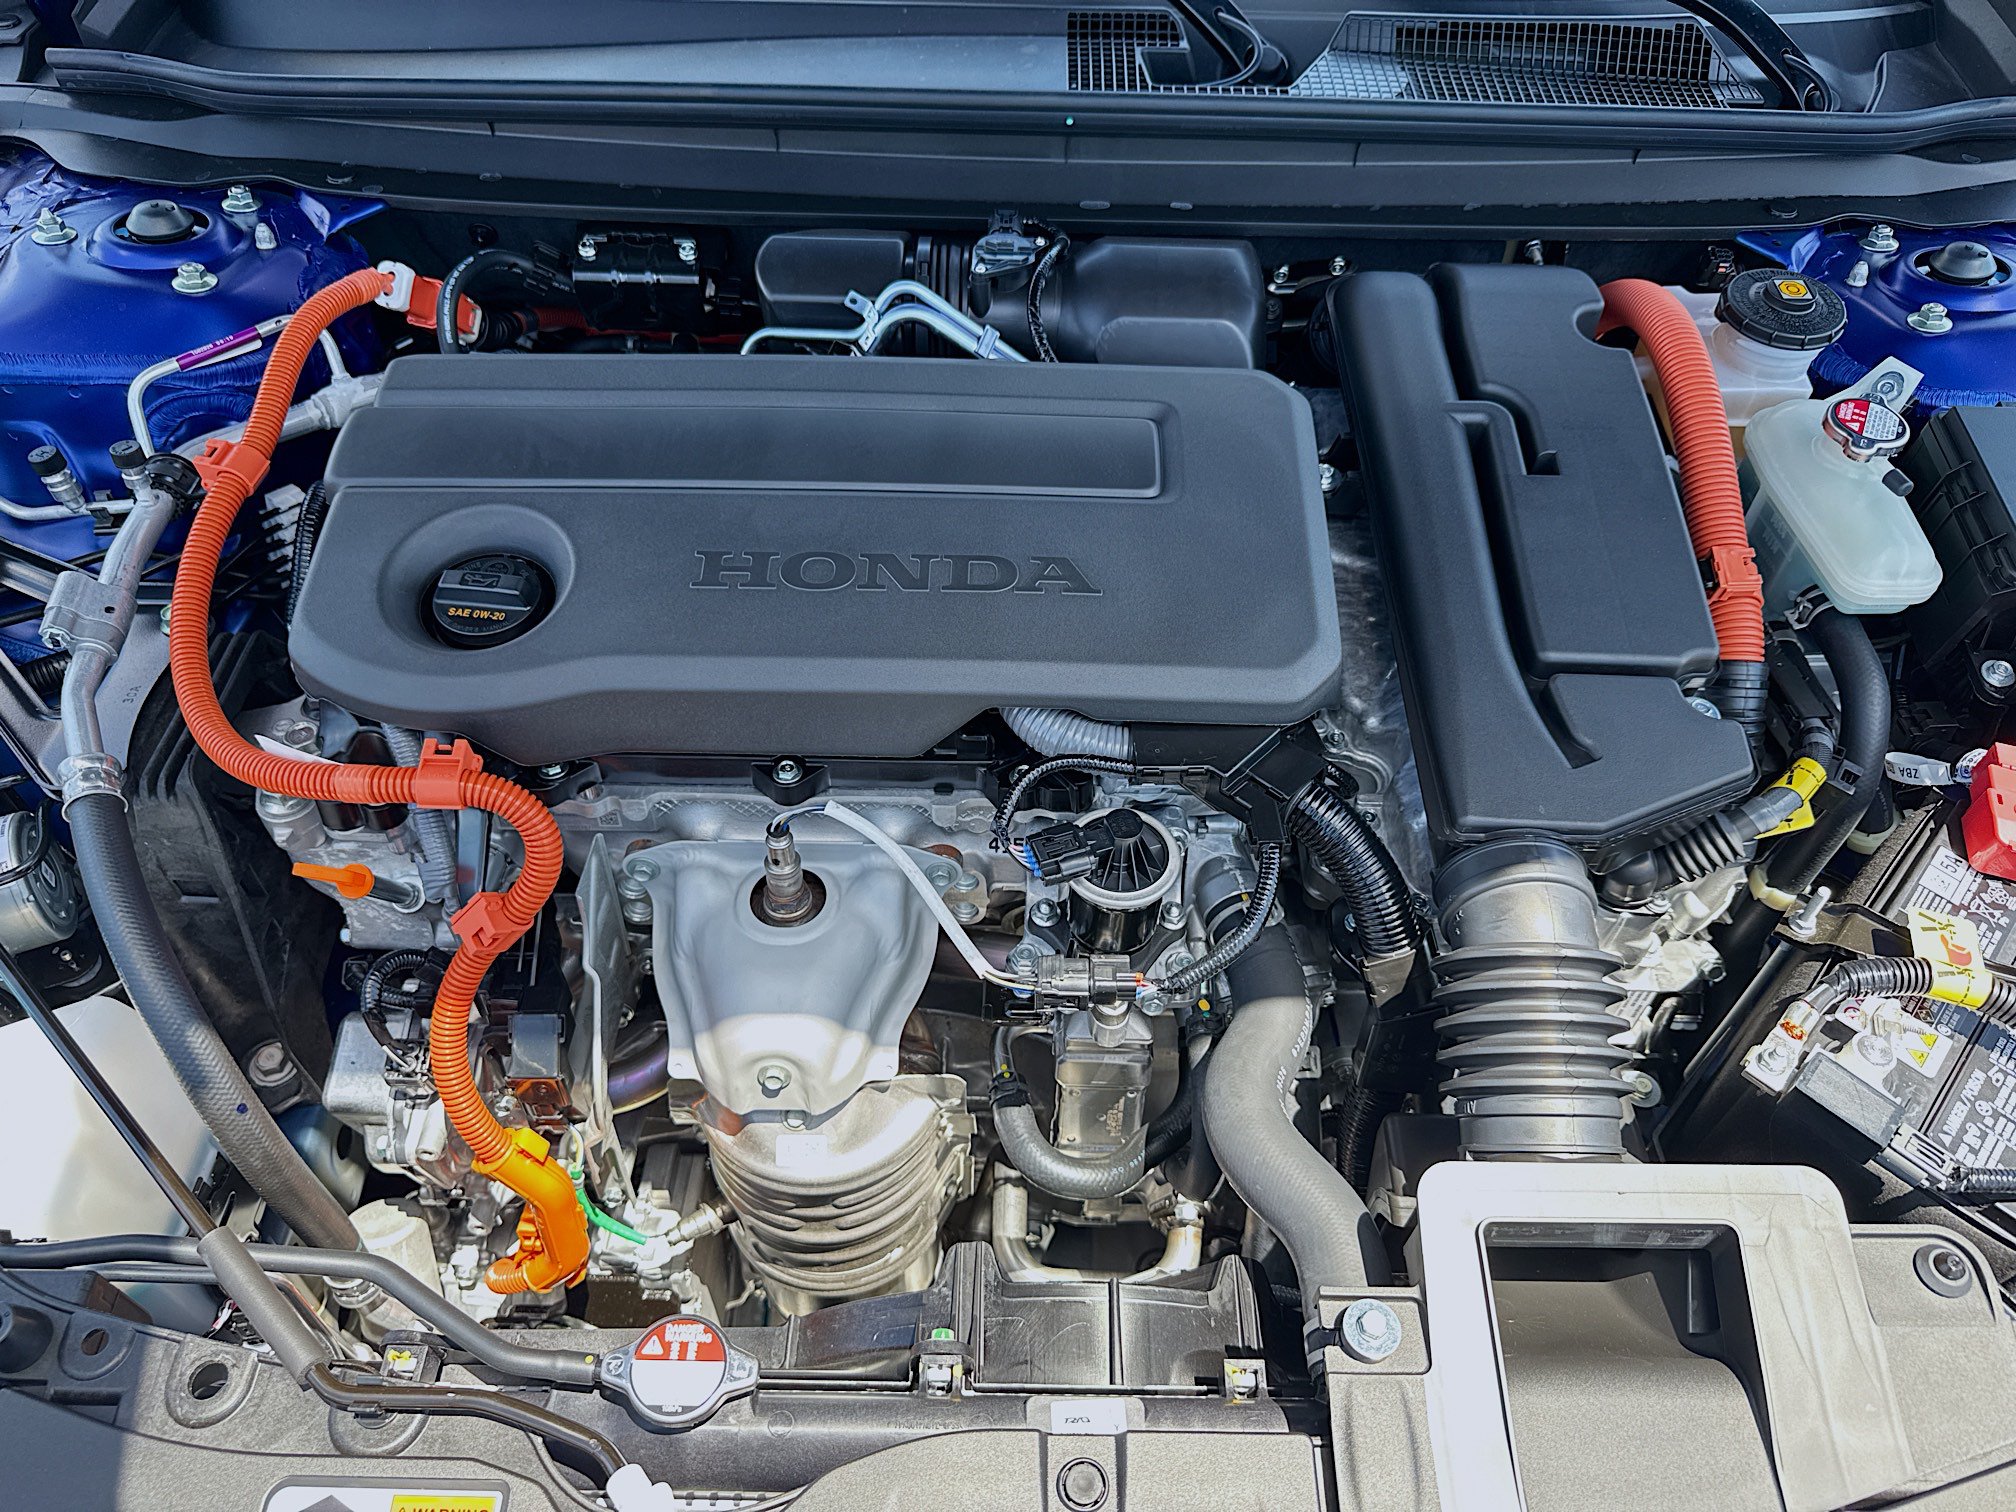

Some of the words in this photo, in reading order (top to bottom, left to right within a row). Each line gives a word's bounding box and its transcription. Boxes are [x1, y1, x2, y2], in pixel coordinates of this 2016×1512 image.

[689, 550, 1103, 595] HONDA
[448, 607, 472, 617] SAE
[472, 609, 506, 621] 0W-20
[1940, 854, 1963, 874] 5A
